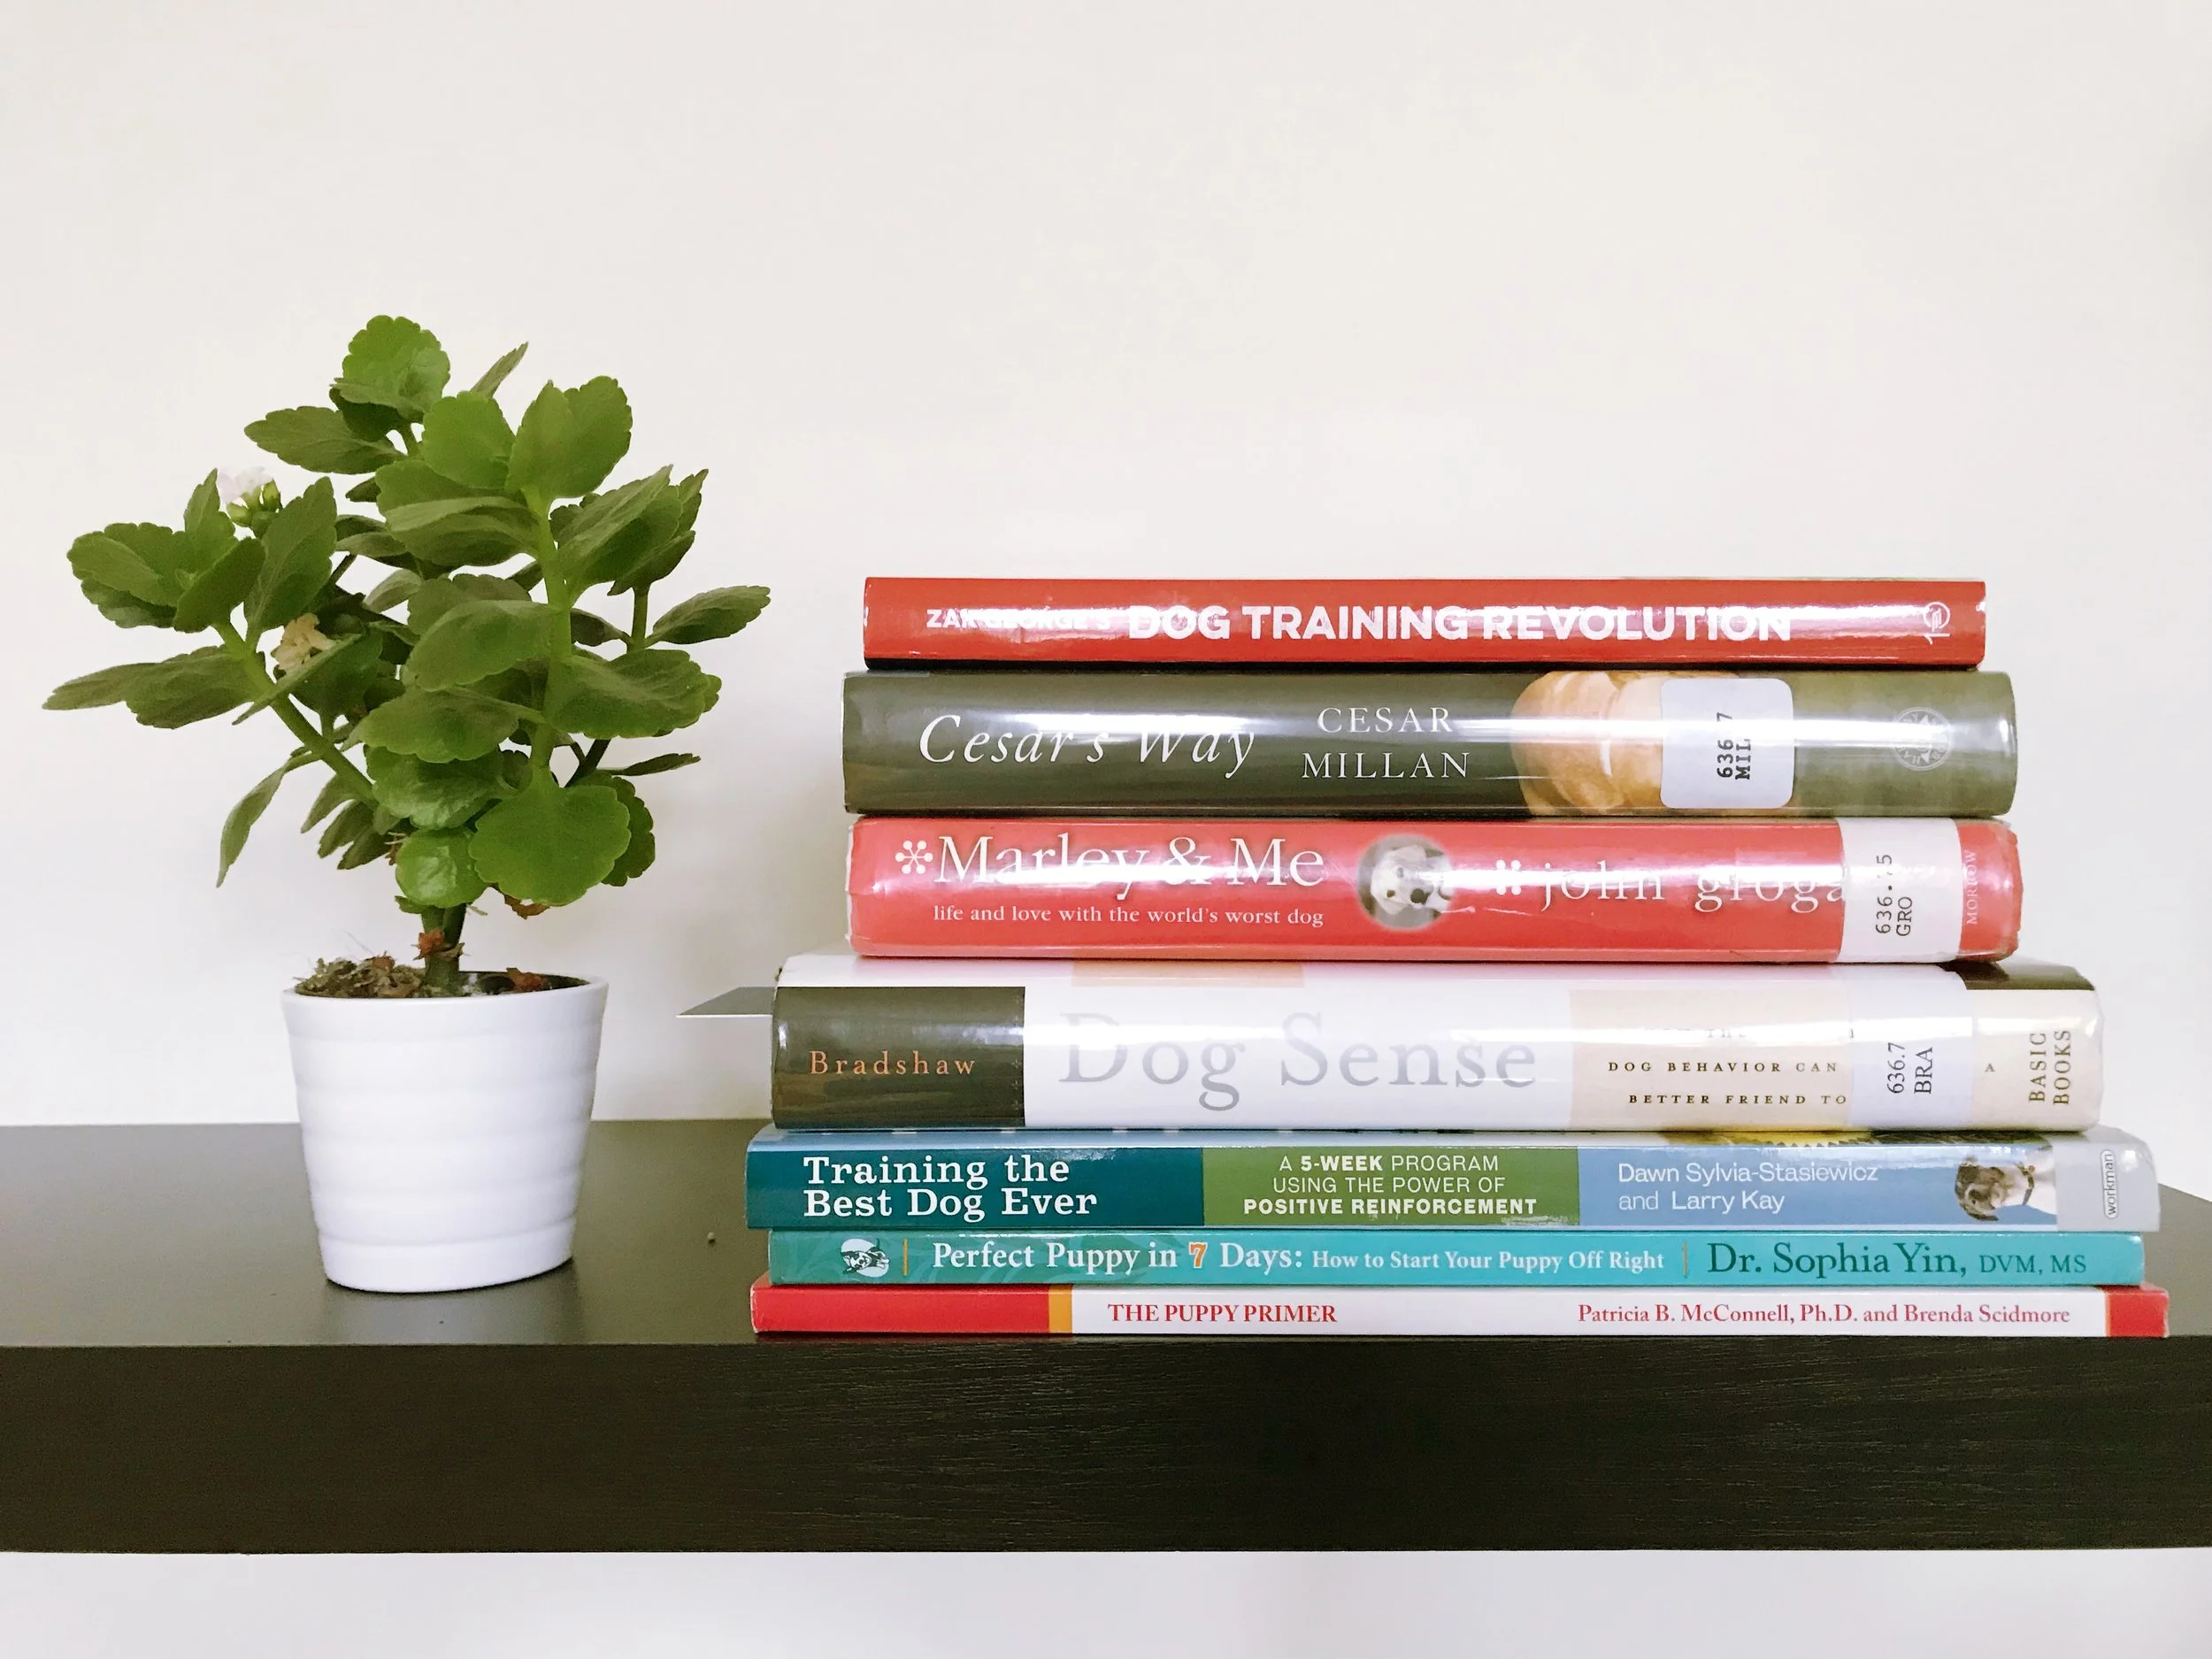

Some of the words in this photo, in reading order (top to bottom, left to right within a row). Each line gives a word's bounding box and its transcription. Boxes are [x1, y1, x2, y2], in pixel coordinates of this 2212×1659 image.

[984, 609, 1111, 629] GEORGES
[1128, 605, 1230, 641] DOG
[1242, 605, 1469, 641] TRAINING
[1484, 605, 1792, 641] REVOLUTION
[1317, 707, 1454, 733] CESAR
[919, 714, 1110, 763] Cesars
[1138, 718, 1255, 779] Way
[1301, 752, 1471, 779] MILLAN
[933, 833, 1150, 901] Marley
[1165, 836, 1212, 886] &
[1228, 837, 1325, 887] Me
[1540, 860, 1666, 912] john
[933, 904, 964, 921] life
[970, 905, 1005, 922] and
[1011, 905, 1052, 922] love
[1058, 906, 1102, 923] with
[1109, 906, 1141, 923] the
[1148, 906, 1218, 924] world's
[1225, 910, 1280, 924] worst
[1287, 908, 1324, 928] dog
[1896, 896, 1913, 937] GRO
[809, 1051, 976, 1076] Bradshaw
[1059, 1011, 1246, 1112] Dog
[1279, 1011, 1536, 1088] Sense
[1608, 1062, 1653, 1072] DOG
[1667, 1062, 1782, 1072] BEHAVIOR
[1795, 1062, 1838, 1072] CAN
[1985, 1063, 1995, 1072] A
[1886, 1041, 1906, 1094] 636.7
[1914, 1046, 1933, 1094] BRA
[2028, 1033, 2047, 1102] BASIC
[2053, 1030, 2071, 1106] BOOKS
[1628, 1094, 1710, 1104] BETTER
[1724, 1094, 1807, 1104] FRIEND
[1820, 1094, 1847, 1104] TO
[803, 1155, 988, 1190] Training
[1004, 1154, 1070, 1182] the
[1279, 1156, 1293, 1171] A
[1300, 1155, 1384, 1171] 5-WEEK
[1392, 1155, 1499, 1171] PROGRAM
[1618, 1163, 1680, 1183] Dawn
[1686, 1161, 1878, 1187] Sylvia-Stasiewicz
[1272, 1177, 1337, 1194] USING
[1345, 1177, 1385, 1193] THE
[1393, 1177, 1471, 1194] POWER
[1478, 1177, 1506, 1193] OF
[1618, 1191, 1659, 1210] and
[1671, 1191, 1735, 1215] Larry
[1741, 1189, 1786, 1215] Kay
[2103, 1153, 2116, 1216] workman
[803, 1189, 893, 1217] Best
[907, 1188, 986, 1224] Dog
[1001, 1187, 1098, 1216] Ever
[1243, 1198, 1344, 1215] POSITIVE
[1351, 1198, 1538, 1215] REINFORCEMENT
[932, 1241, 1035, 1268] Perfect
[1047, 1242, 1140, 1275] Puppy
[1148, 1241, 1179, 1268] in
[1187, 1241, 1209, 1268] 7
[1219, 1242, 1302, 1276] Days:
[1312, 1250, 1361, 1268] How
[1364, 1253, 1385, 1268] to
[1390, 1250, 1440, 1268] Start
[1444, 1250, 1493, 1269] Your
[1499, 1251, 1563, 1274] Puppy
[1569, 1250, 1606, 1269] Off
[1609, 1250, 1664, 1274] Right
[1707, 1242, 1763, 1273] Dr.
[1773, 1241, 1889, 1279] Sophia
[1893, 1241, 1967, 1278] Yin,
[1979, 1254, 2043, 1277] DVM,
[2051, 1254, 2087, 1274] MS
[1107, 1303, 1160, 1322] THE
[1164, 1304, 1240, 1323] PUPPY
[1243, 1304, 1338, 1323] PRIMER
[1578, 1303, 1650, 1323] Patricia
[1654, 1303, 1676, 1323] B.
[1680, 1303, 1795, 1325] McConnell,
[1800, 1303, 1857, 1323] Ph.D.
[1863, 1303, 1898, 1323] and
[1903, 1303, 1974, 1324] Brenda
[1978, 1303, 2070, 1324] Scidmore
